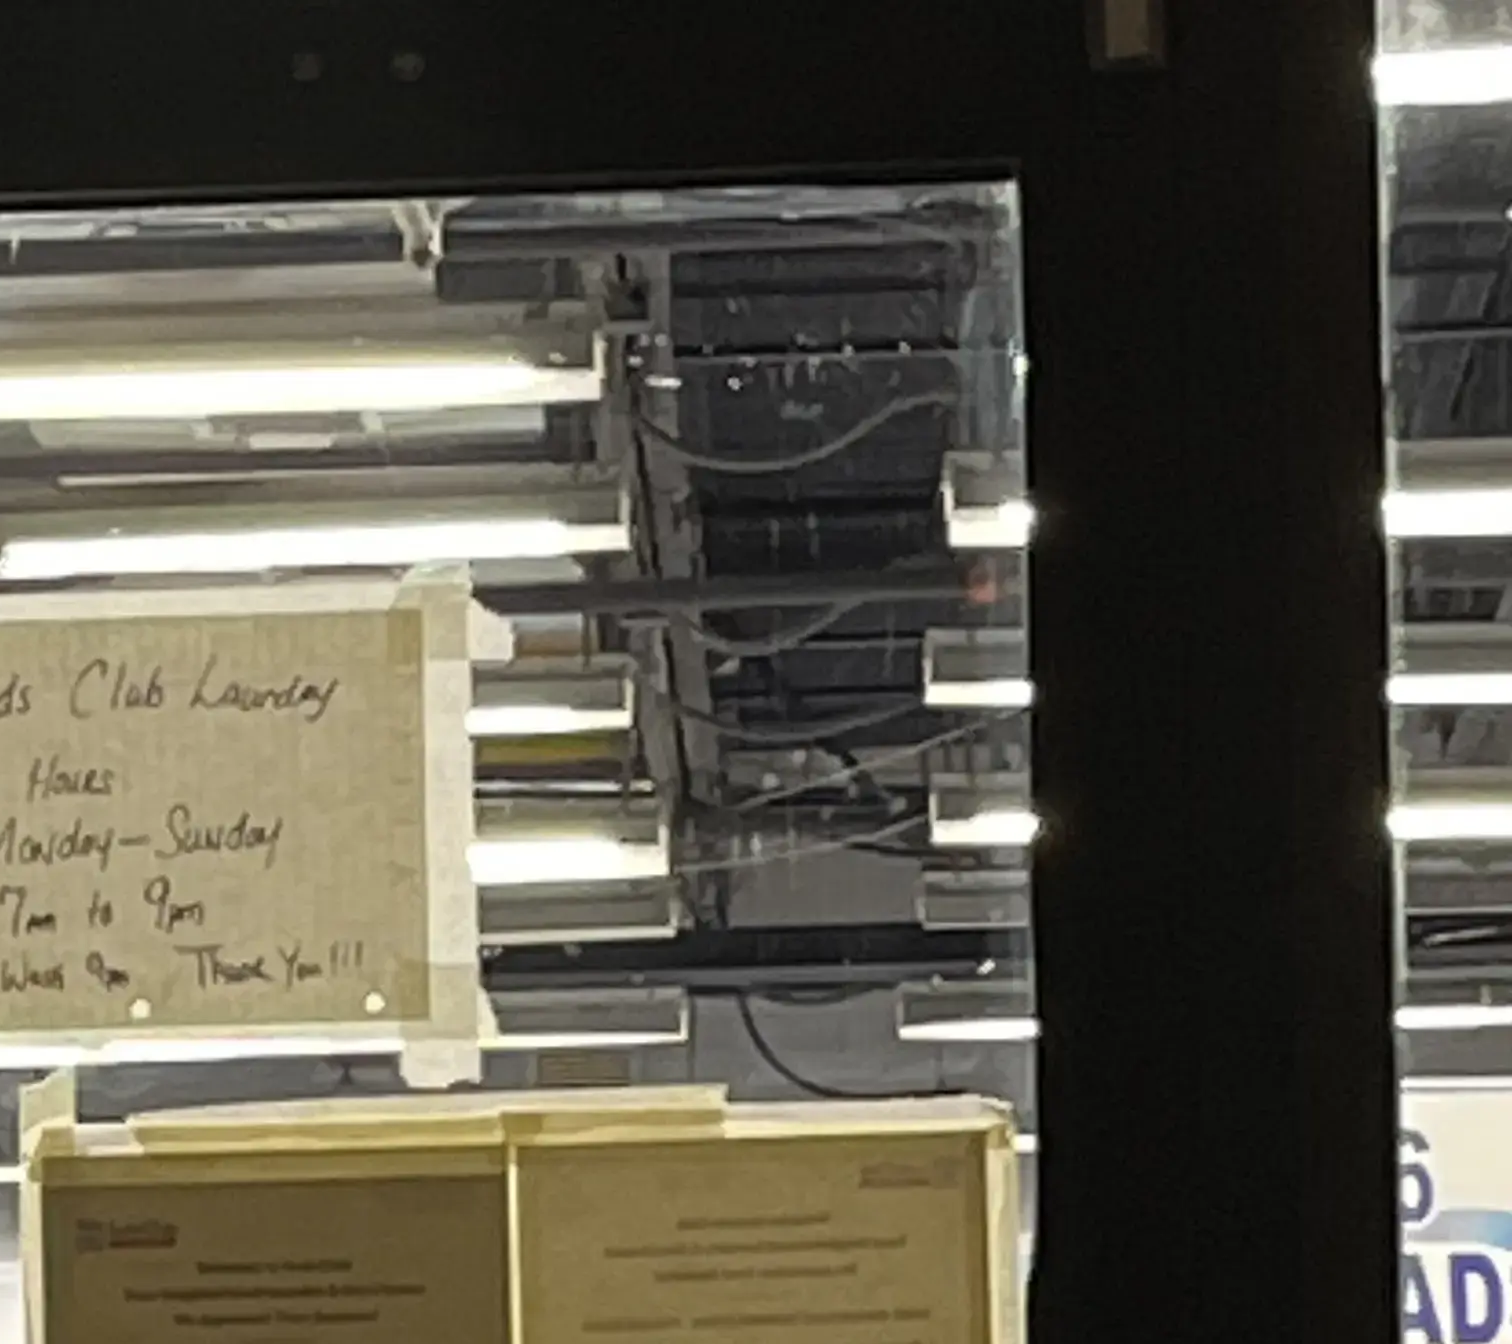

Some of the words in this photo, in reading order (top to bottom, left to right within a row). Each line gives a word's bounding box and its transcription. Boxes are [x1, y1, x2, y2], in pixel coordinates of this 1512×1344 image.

[68, 656, 164, 717] Club
[26, 754, 115, 800] Hours
[87, 888, 114, 928] to
[143, 875, 207, 932] 9pm
